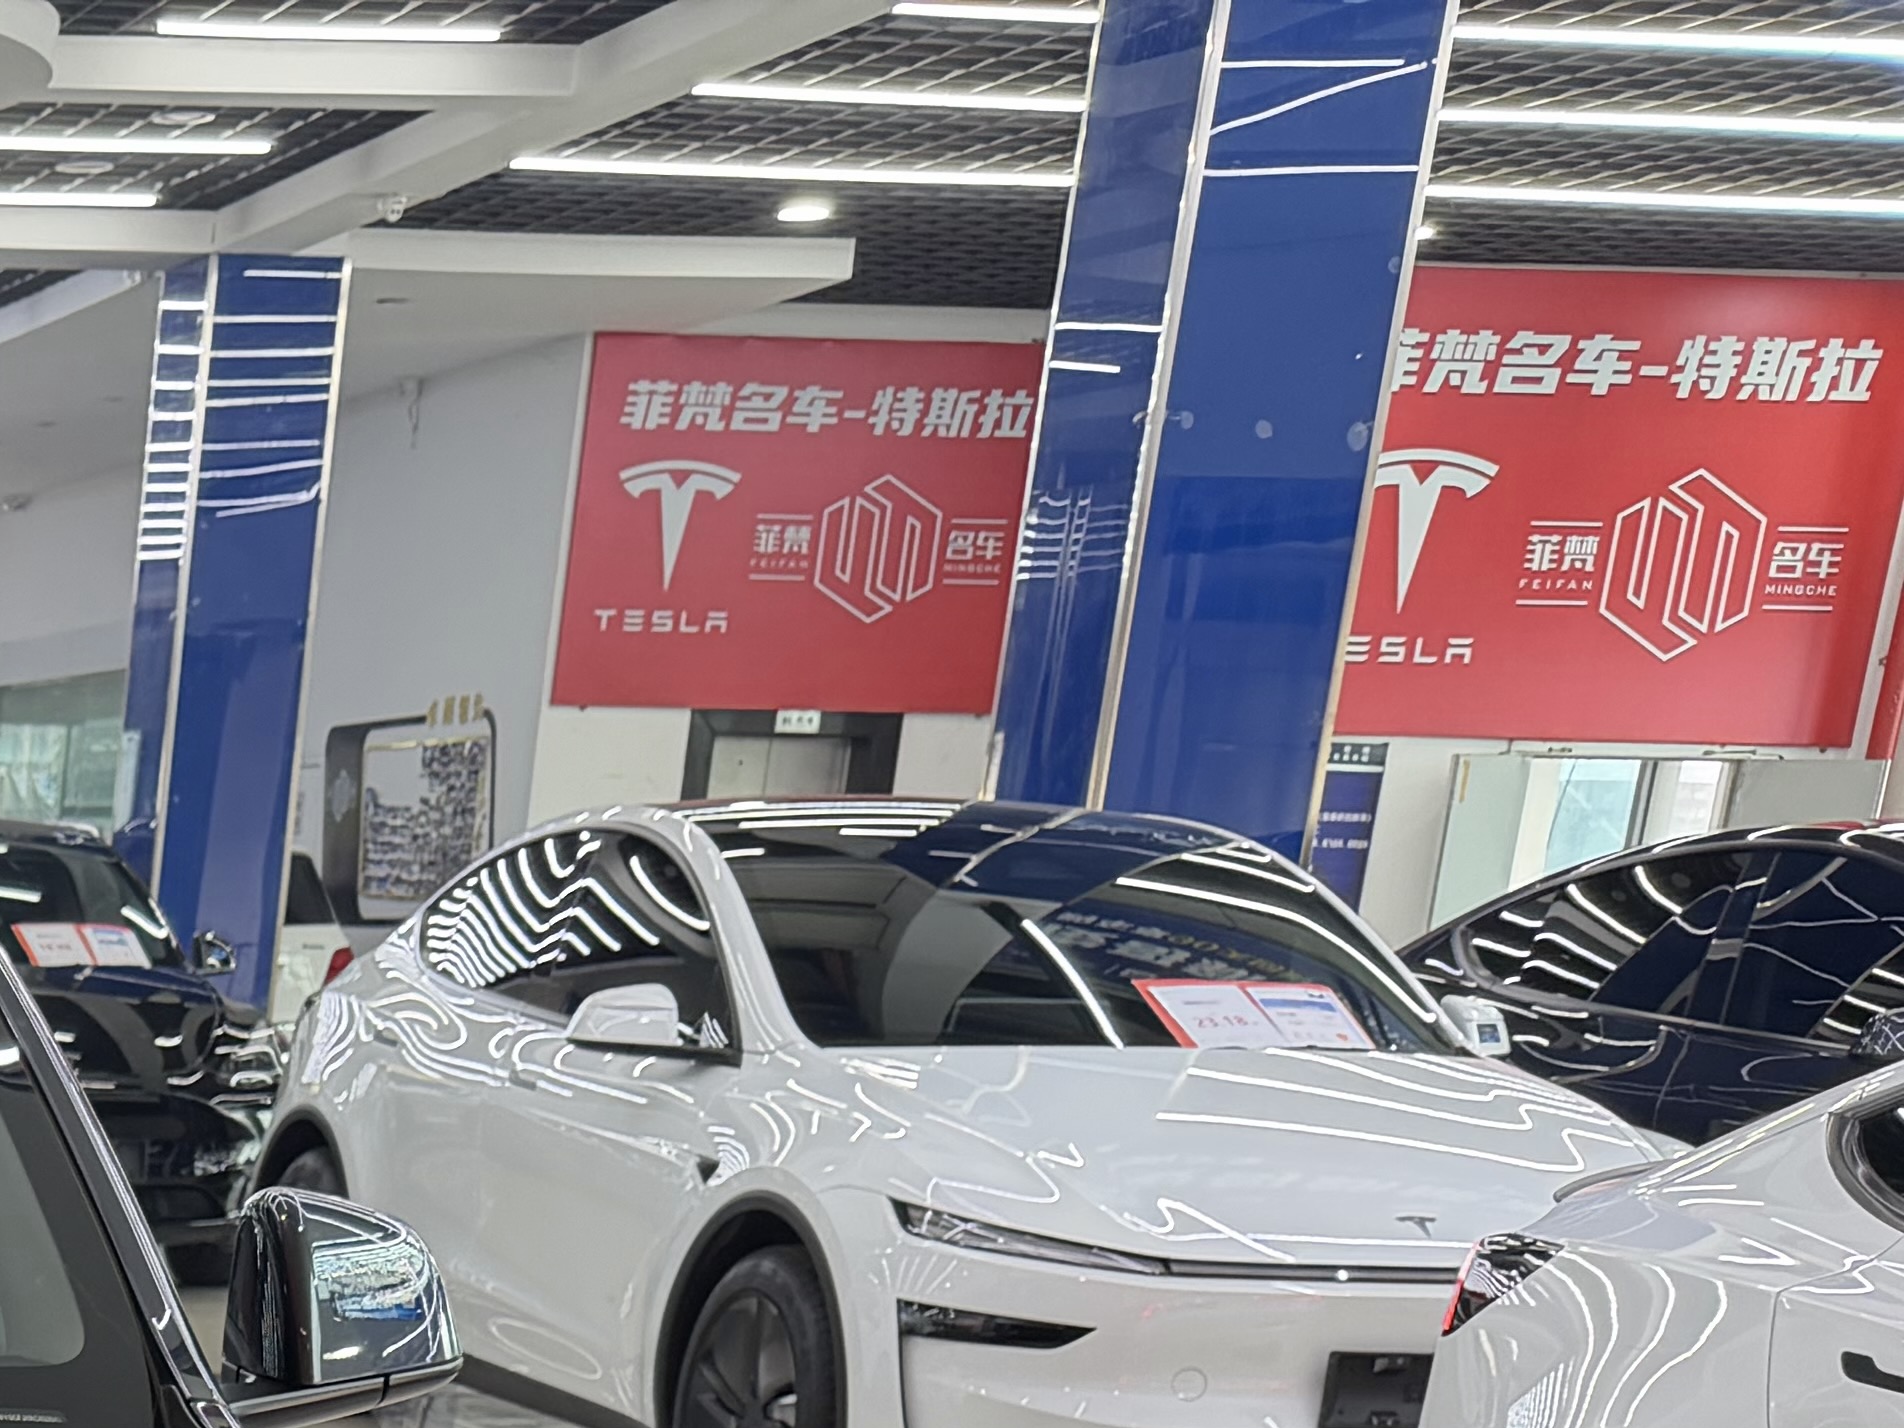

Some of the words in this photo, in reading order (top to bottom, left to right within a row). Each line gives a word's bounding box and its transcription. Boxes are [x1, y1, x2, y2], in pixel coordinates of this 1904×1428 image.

[618, 378, 1035, 440] 菲梵名车-特斯拉
[751, 524, 811, 556] 菲梵
[945, 529, 1005, 561] 名车
[1522, 533, 1600, 574] 菲梵
[1769, 540, 1845, 580] 名车
[1517, 577, 1594, 592] FEIFAN
[1764, 582, 1838, 598] MINGCHE
[594, 608, 729, 634] TESLA
